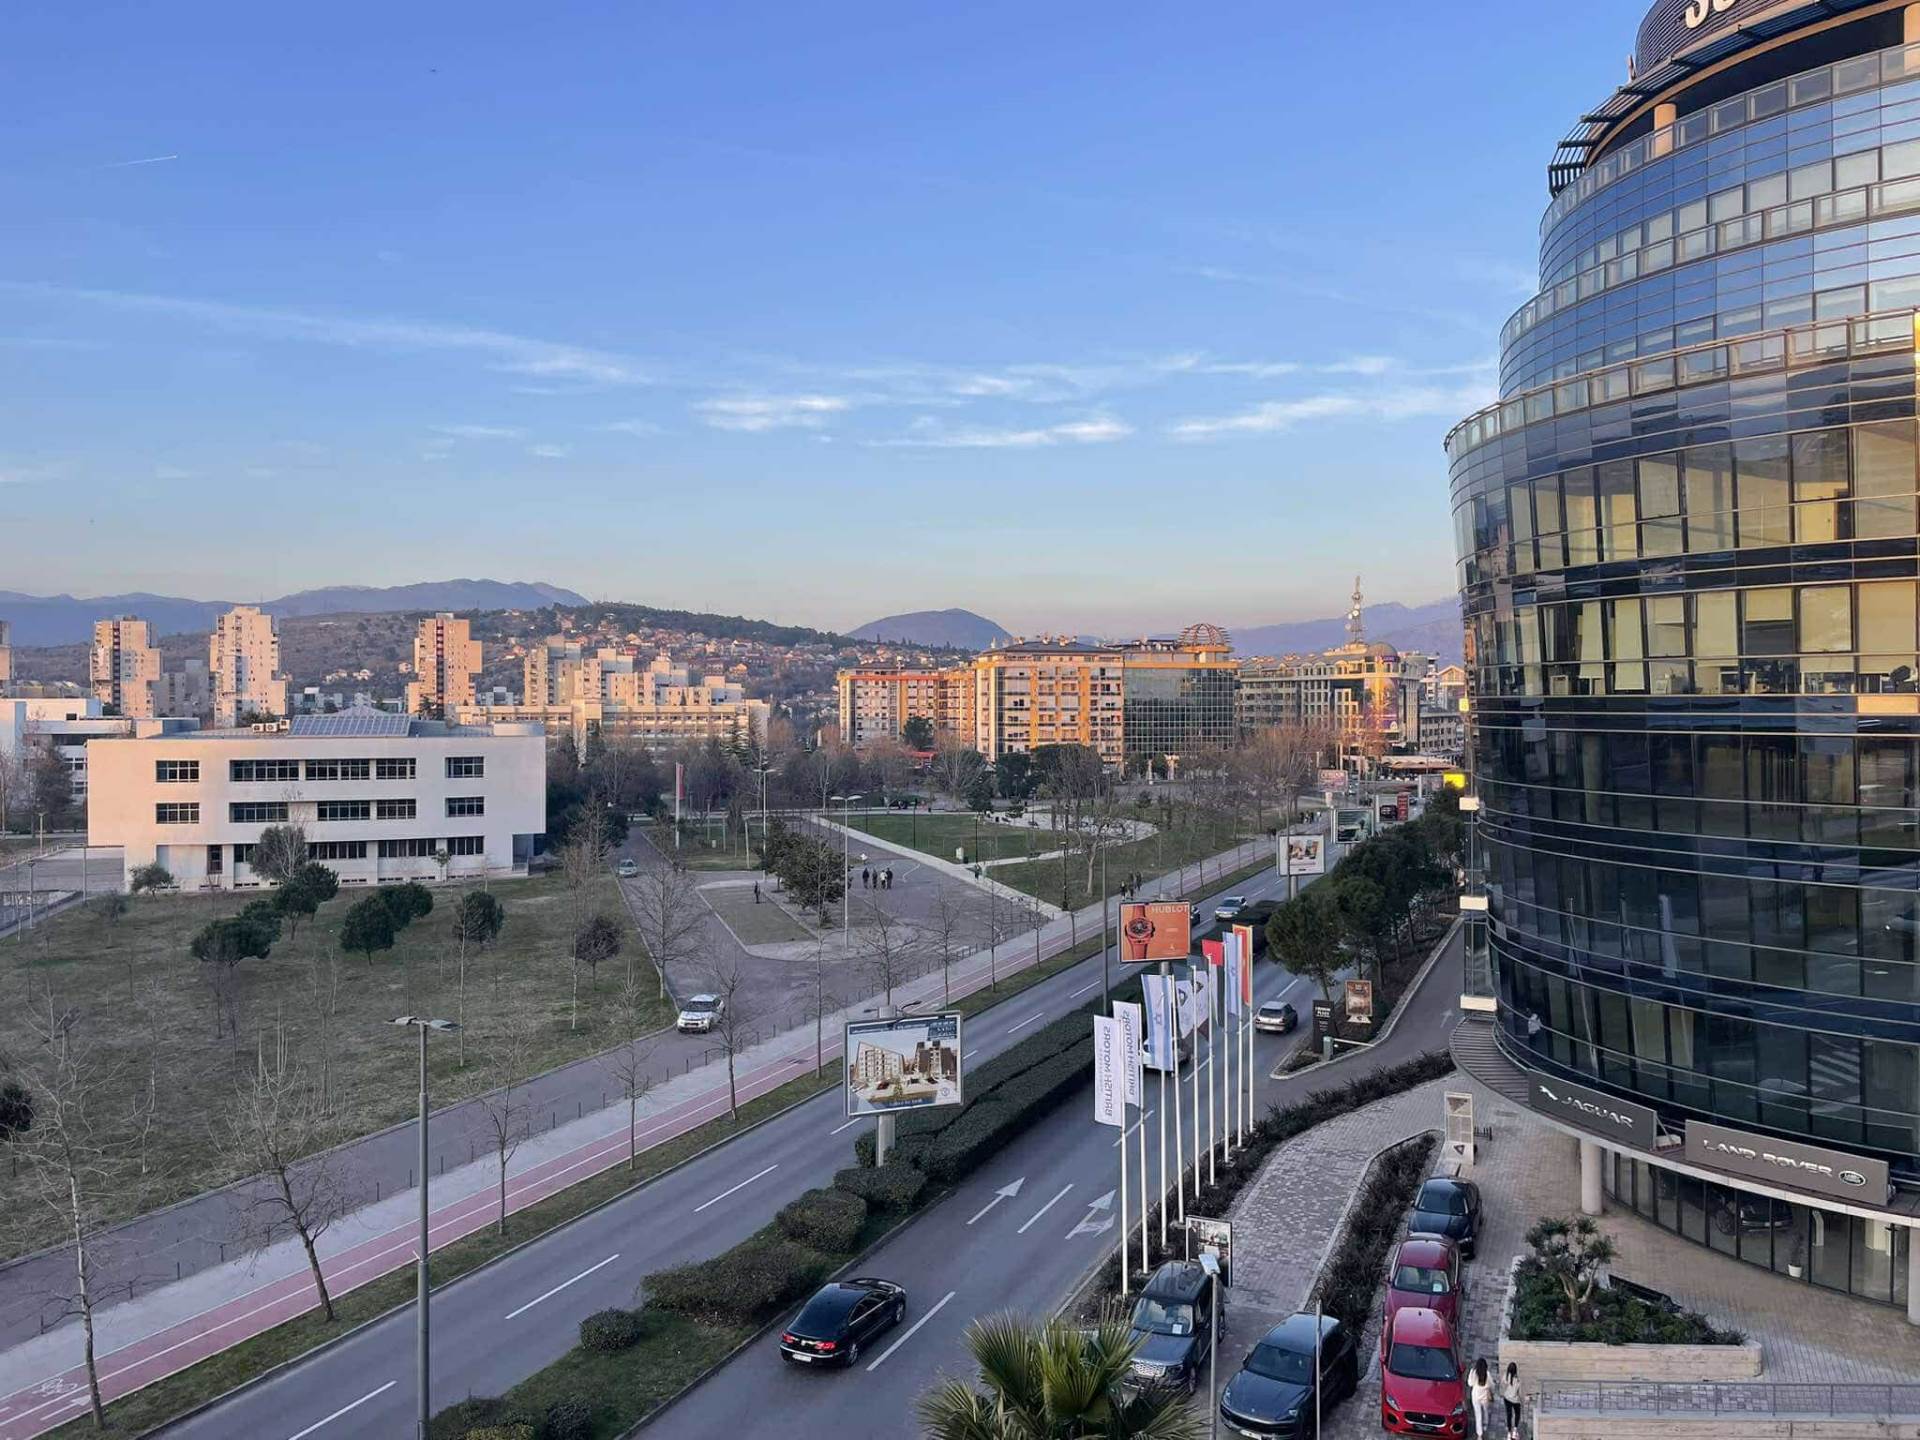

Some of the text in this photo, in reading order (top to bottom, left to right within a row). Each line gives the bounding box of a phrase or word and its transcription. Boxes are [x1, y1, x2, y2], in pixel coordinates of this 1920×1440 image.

[1151, 905, 1187, 913] HUBLOT
[1561, 1096, 1633, 1128] JAGUAR
[1703, 1139, 1833, 1177] LAND ROVER
